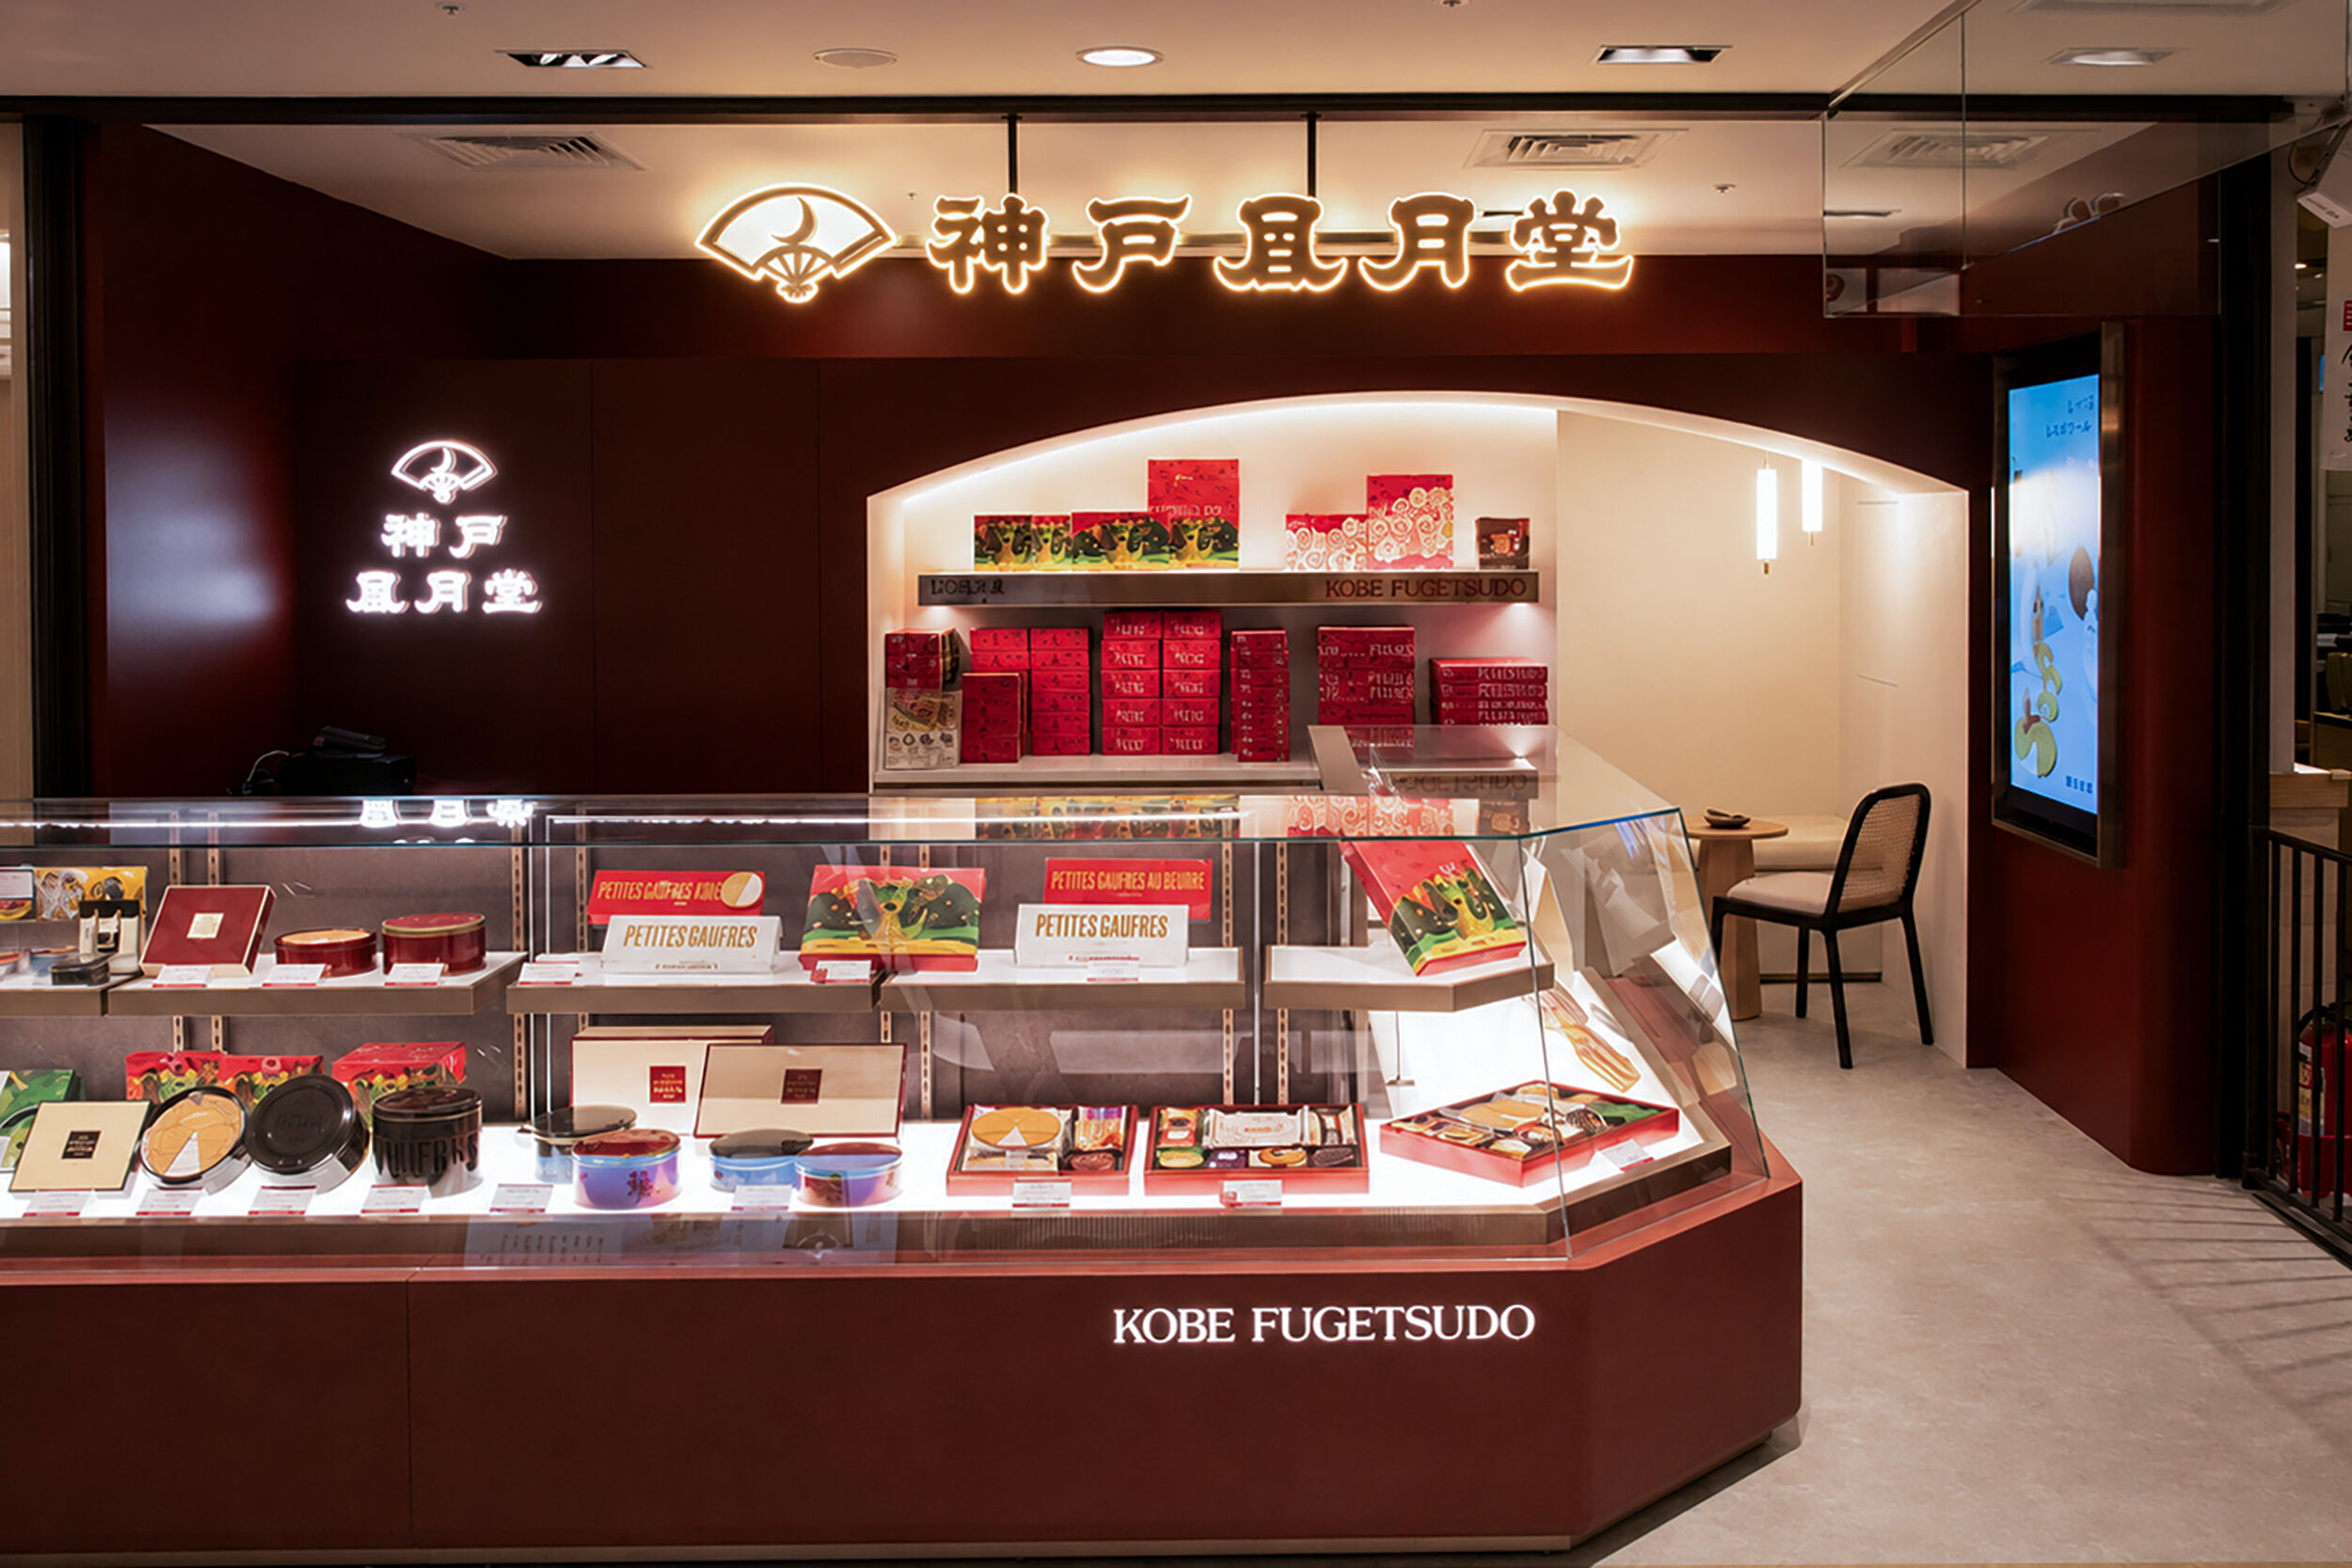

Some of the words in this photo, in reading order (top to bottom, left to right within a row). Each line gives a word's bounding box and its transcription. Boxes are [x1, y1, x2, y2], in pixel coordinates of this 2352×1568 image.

[1325, 579, 1383, 598] KOBE
[1391, 578, 1527, 597] FUGETSUDO
[596, 880, 644, 900] PETITES
[1050, 870, 1095, 892] PETITES
[623, 924, 688, 948] PETITES
[689, 925, 758, 948] GAUFRES
[1036, 912, 1098, 938] PETITES
[1100, 913, 1168, 939] GAUFRES
[1113, 1308, 1235, 1344] KOBE
[1251, 1304, 1535, 1343] FUGETSUDO
